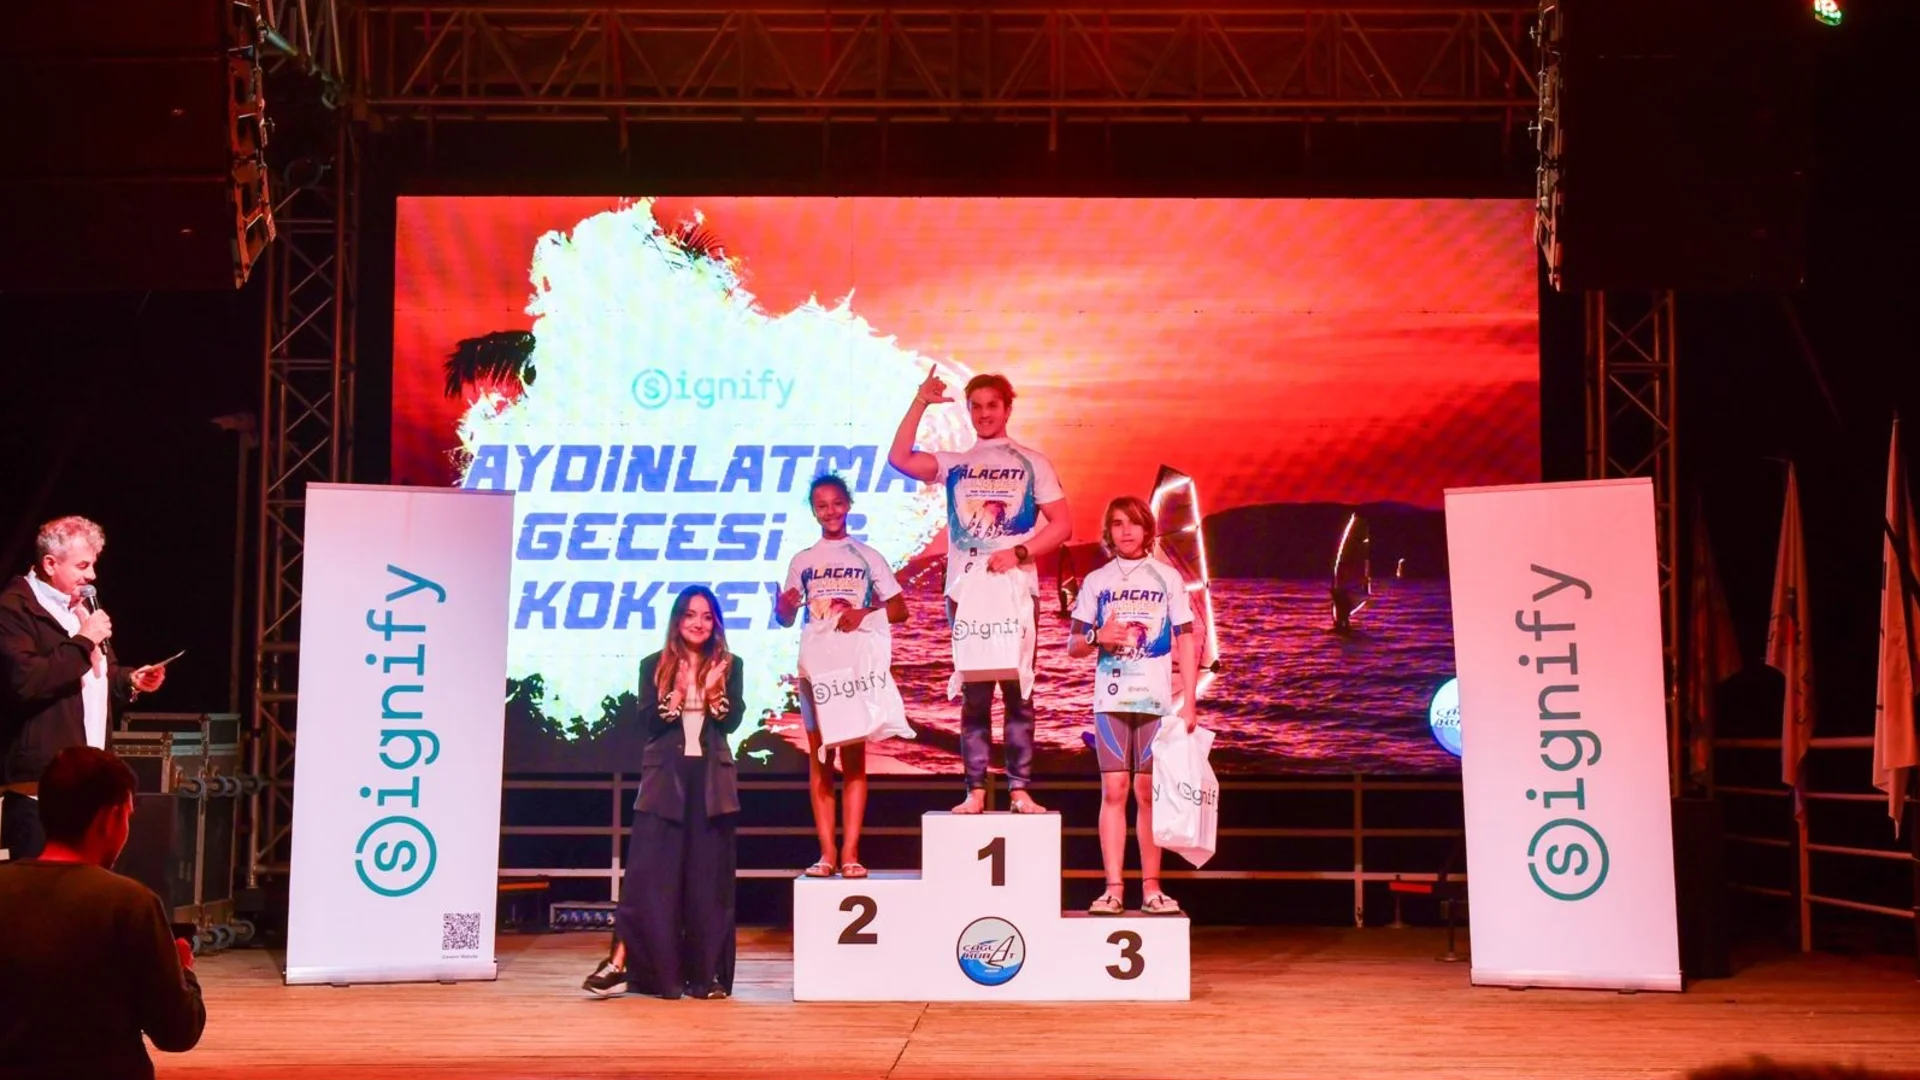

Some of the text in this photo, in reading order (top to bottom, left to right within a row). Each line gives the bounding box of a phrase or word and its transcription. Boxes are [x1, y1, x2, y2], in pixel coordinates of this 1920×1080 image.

[632, 368, 794, 410] signify
[811, 671, 888, 705] signify
[355, 563, 447, 898] signify
[1515, 563, 1610, 902] signify
[978, 837, 1006, 887] 1
[837, 895, 878, 944] 2
[1105, 930, 1145, 980] 3
